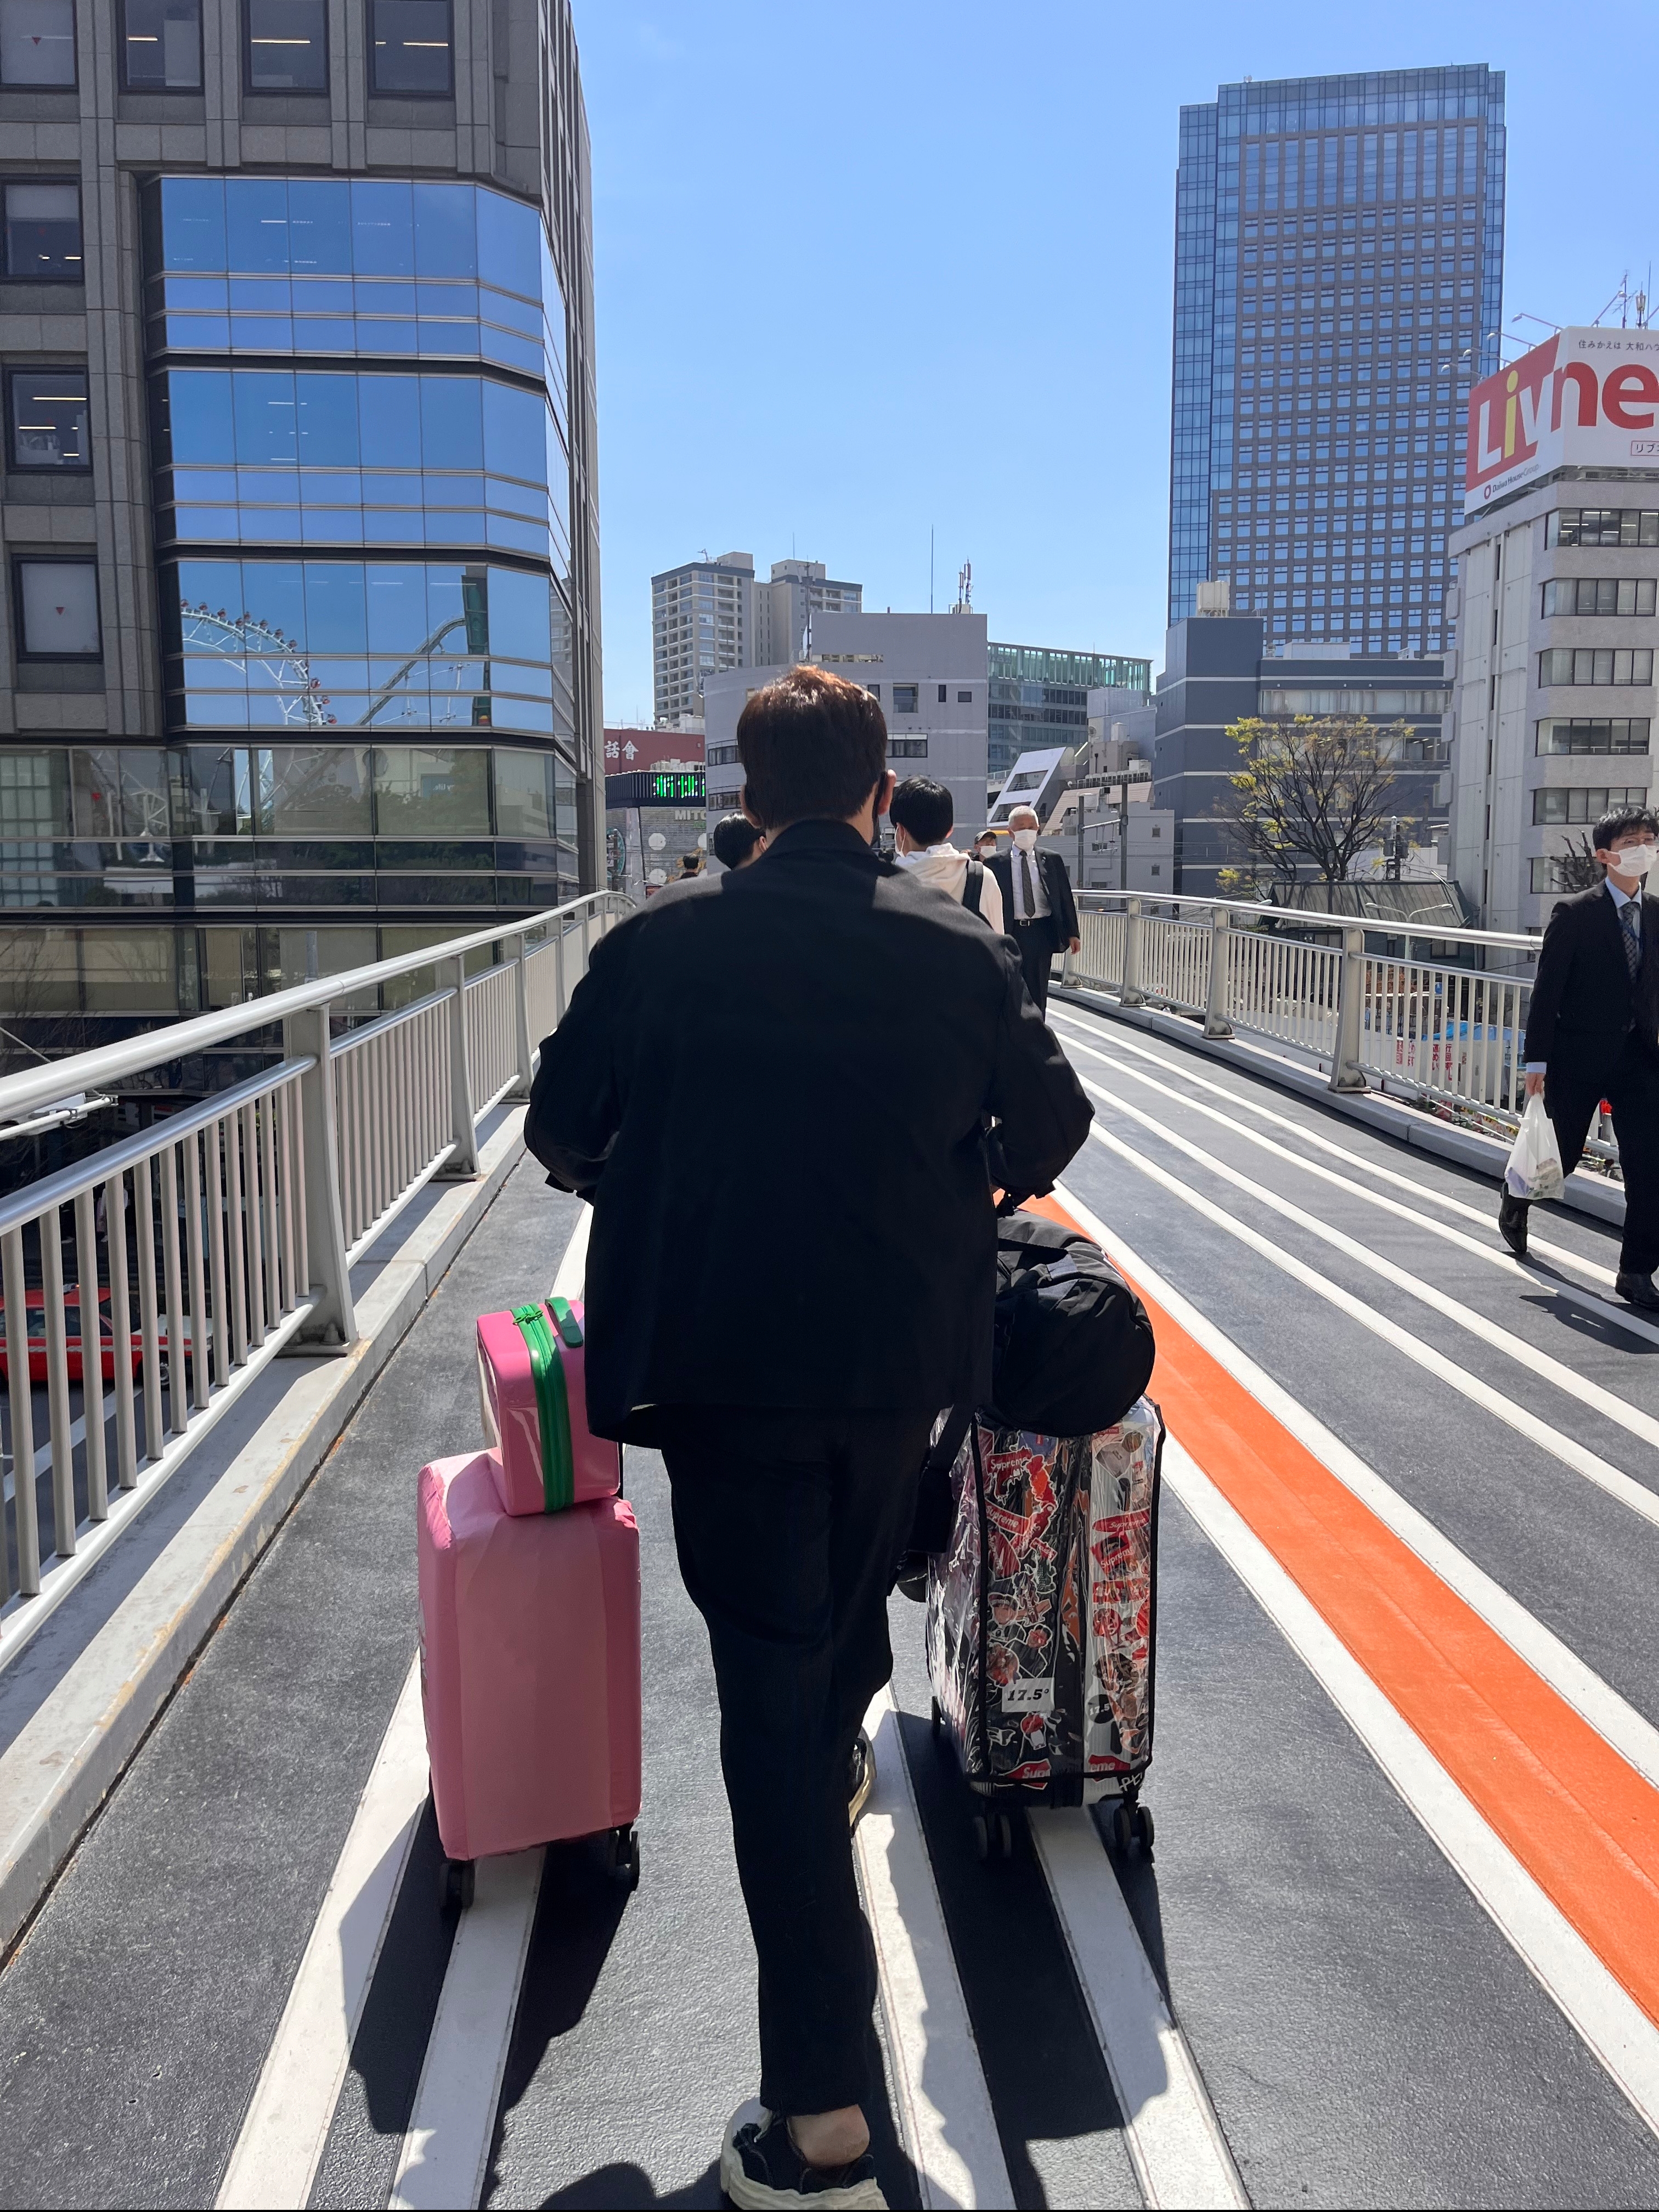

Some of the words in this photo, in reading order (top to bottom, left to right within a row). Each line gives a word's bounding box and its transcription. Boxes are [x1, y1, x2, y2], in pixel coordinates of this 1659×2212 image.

[1578, 339, 1621, 349] 住みかえは
[1636, 443, 1659, 454] リブ
[1492, 480, 1508, 493] Daiwa
[1508, 472, 1523, 485] House
[986, 1505, 1019, 1528] Supreme
[1100, 1545, 1135, 1568] Supreme
